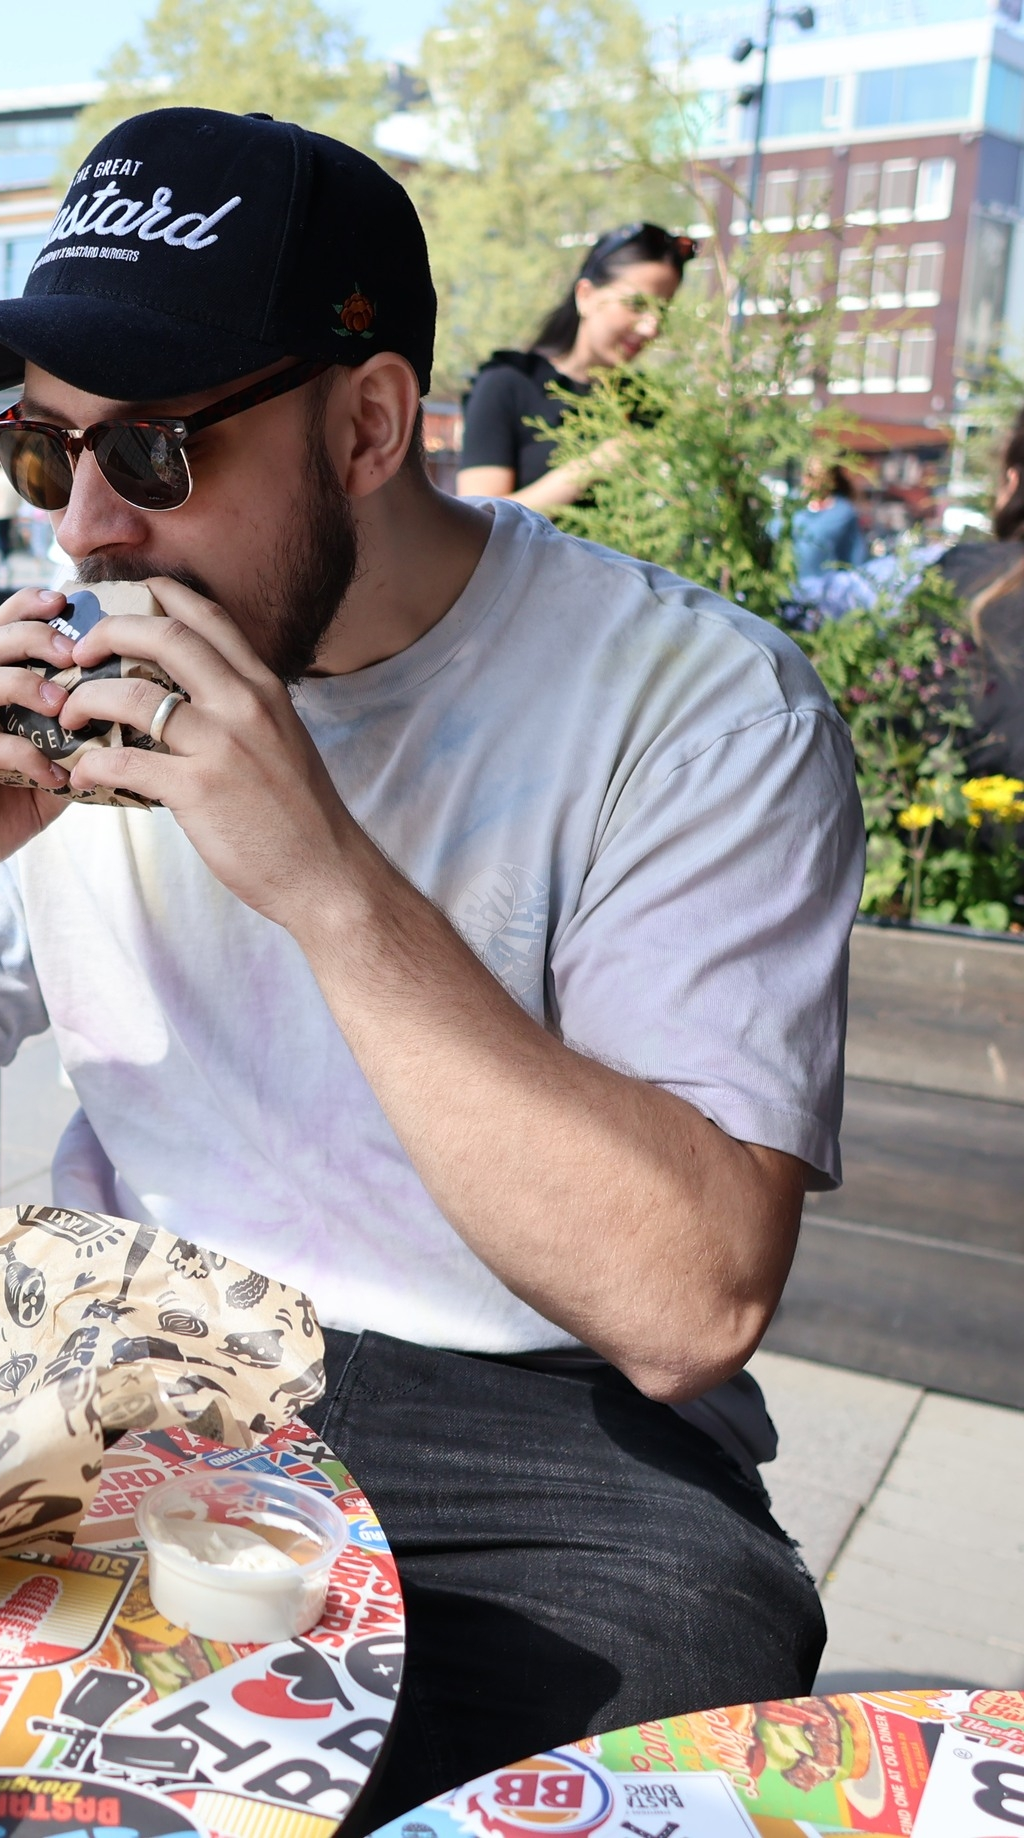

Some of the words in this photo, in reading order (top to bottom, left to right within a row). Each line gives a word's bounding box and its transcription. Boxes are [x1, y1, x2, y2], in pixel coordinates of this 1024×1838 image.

[93, 158, 144, 178] GREAT
[65, 245, 99, 258] BASTARD
[98, 247, 140, 262] BURGERS
[208, 1444, 270, 1467] BASTARD
[875, 1713, 894, 1744] DINER
[882, 1743, 900, 1768] OUR
[887, 1768, 903, 1783] AT
[492, 1772, 586, 1809] BB
[891, 1783, 910, 1810] ONE
[897, 1808, 914, 1835] FIND
